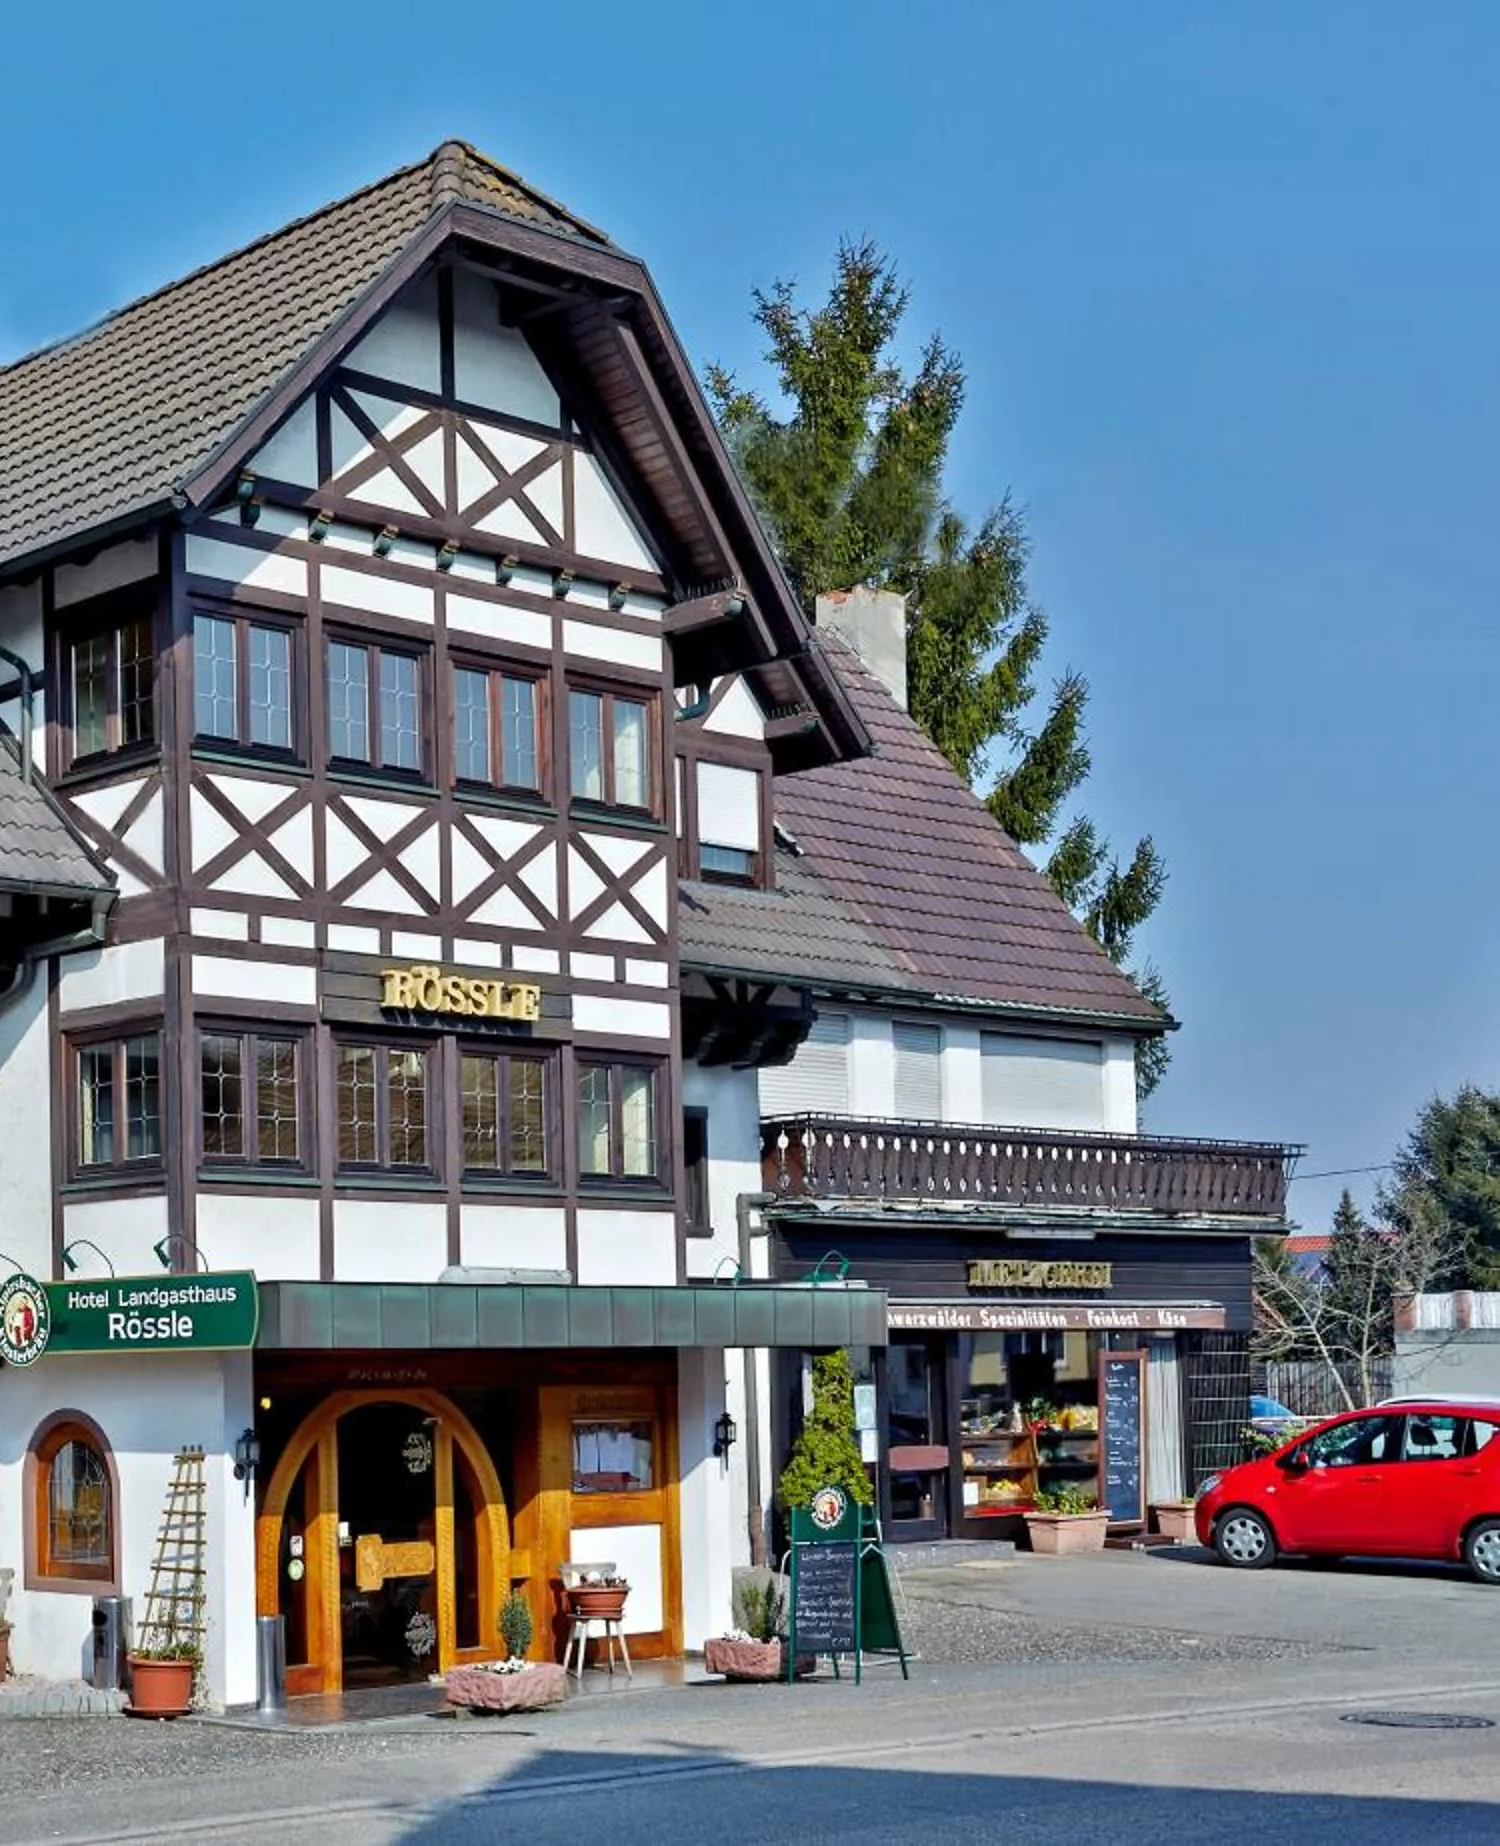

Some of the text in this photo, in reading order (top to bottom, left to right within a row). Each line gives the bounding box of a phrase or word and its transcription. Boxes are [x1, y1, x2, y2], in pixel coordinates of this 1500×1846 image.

[381, 965, 541, 1022] RÖSSLE
[67, 1284, 237, 1310] Hotel Landgasthaus
[108, 1310, 193, 1340] Rössle
[979, 1307, 1068, 1329] Spezialitäten
[1087, 1307, 1140, 1328] Feinkost
[1157, 1308, 1187, 1327] Käse
